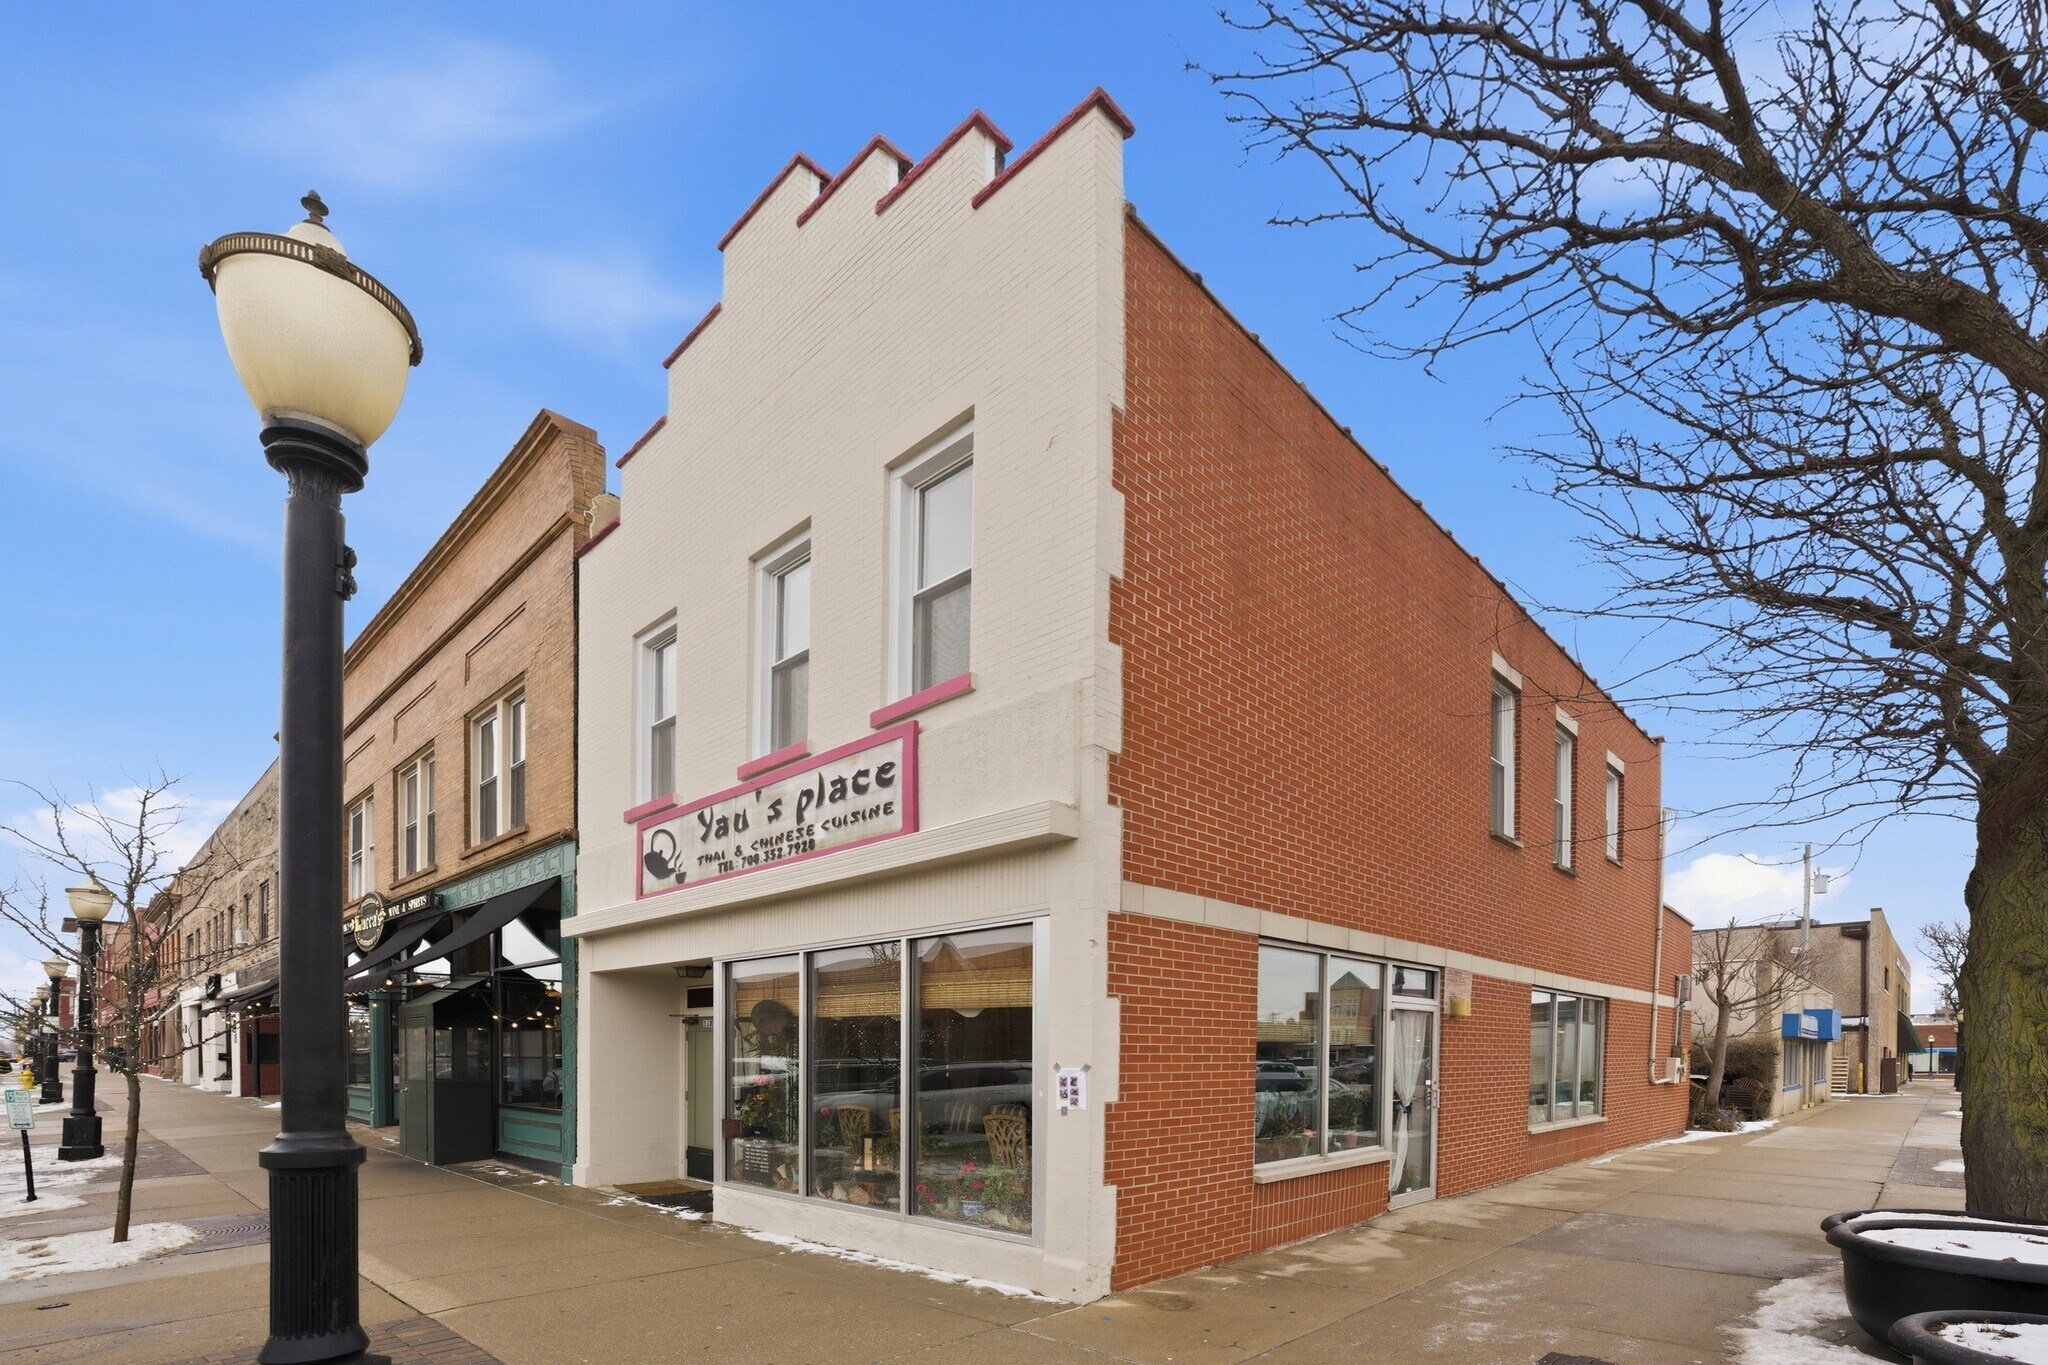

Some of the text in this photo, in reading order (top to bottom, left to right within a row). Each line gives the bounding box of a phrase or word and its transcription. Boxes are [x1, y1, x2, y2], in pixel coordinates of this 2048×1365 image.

[697, 762, 896, 843] Yau's place
[697, 801, 894, 866] THAI & CHINESE CUISINE
